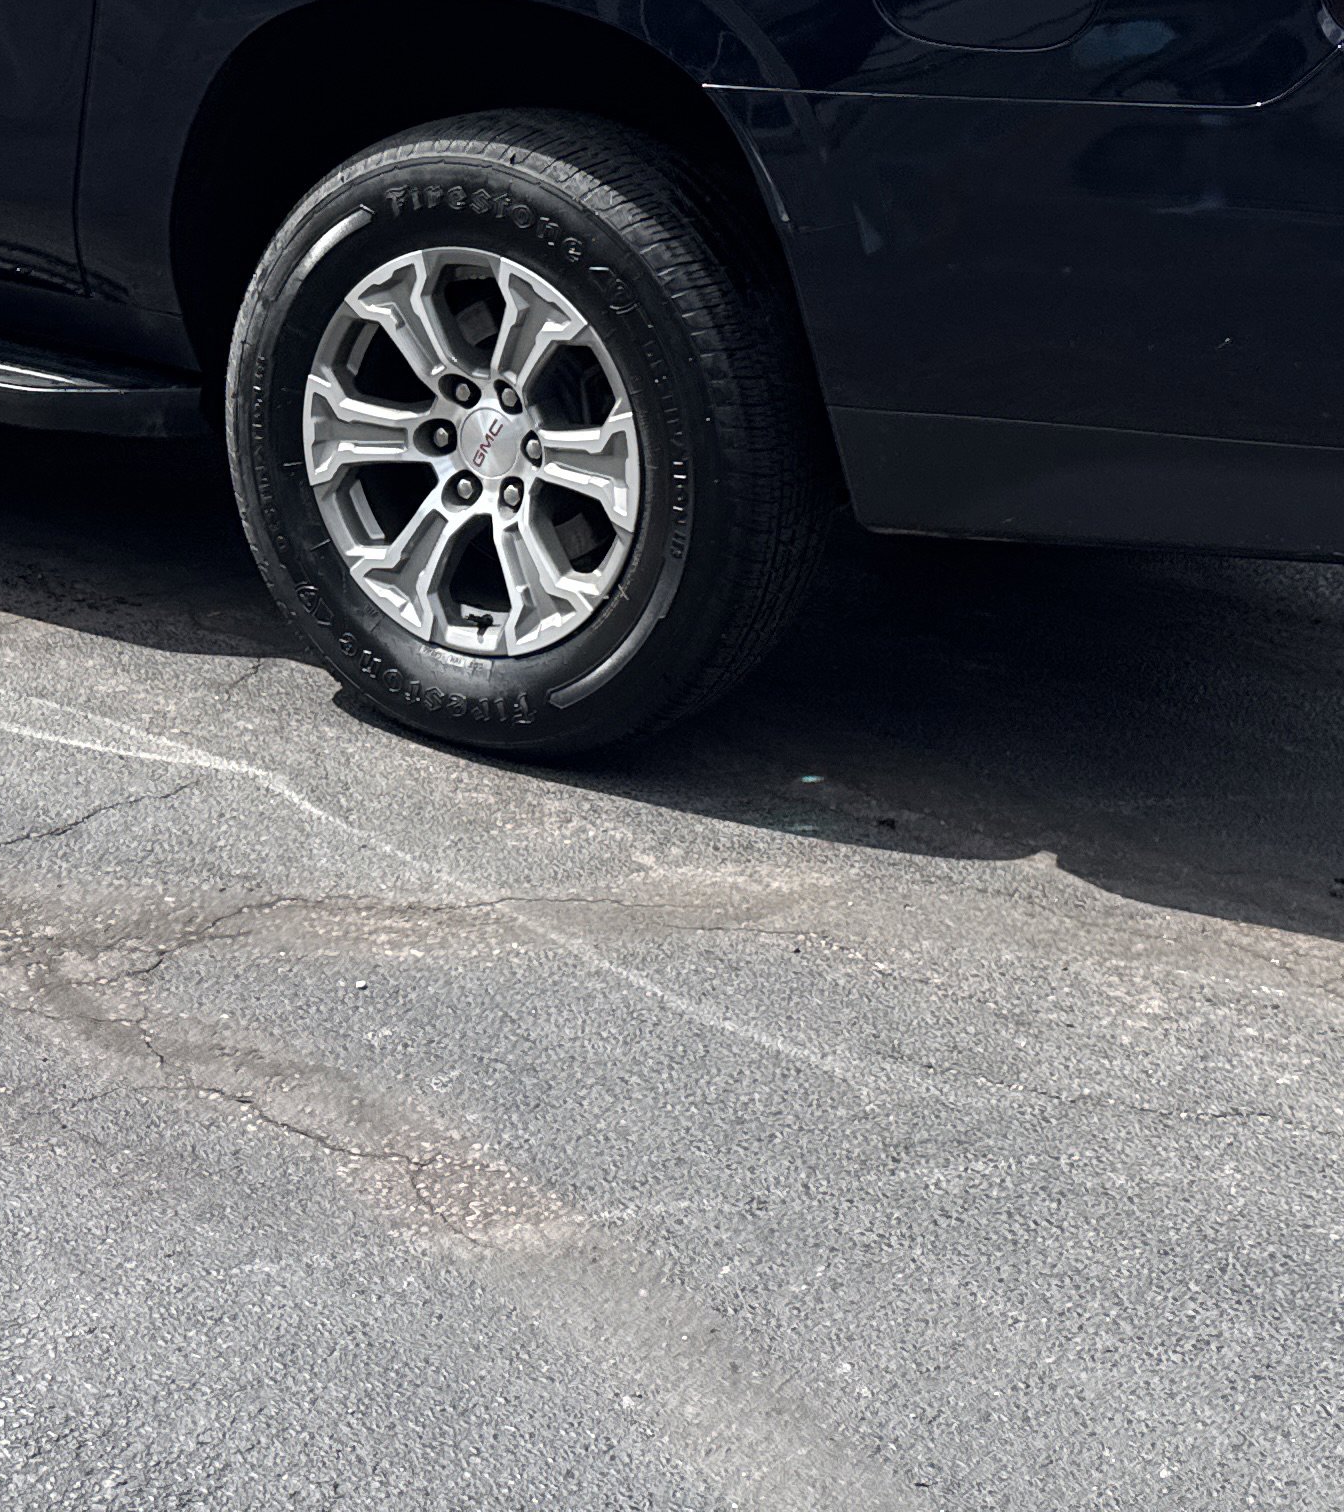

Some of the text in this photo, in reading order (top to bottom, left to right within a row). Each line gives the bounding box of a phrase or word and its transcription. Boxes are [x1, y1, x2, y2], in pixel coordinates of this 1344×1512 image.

[384, 184, 583, 264] Firestone
[472, 417, 504, 468] GMC
[338, 631, 538, 726] Firestone
